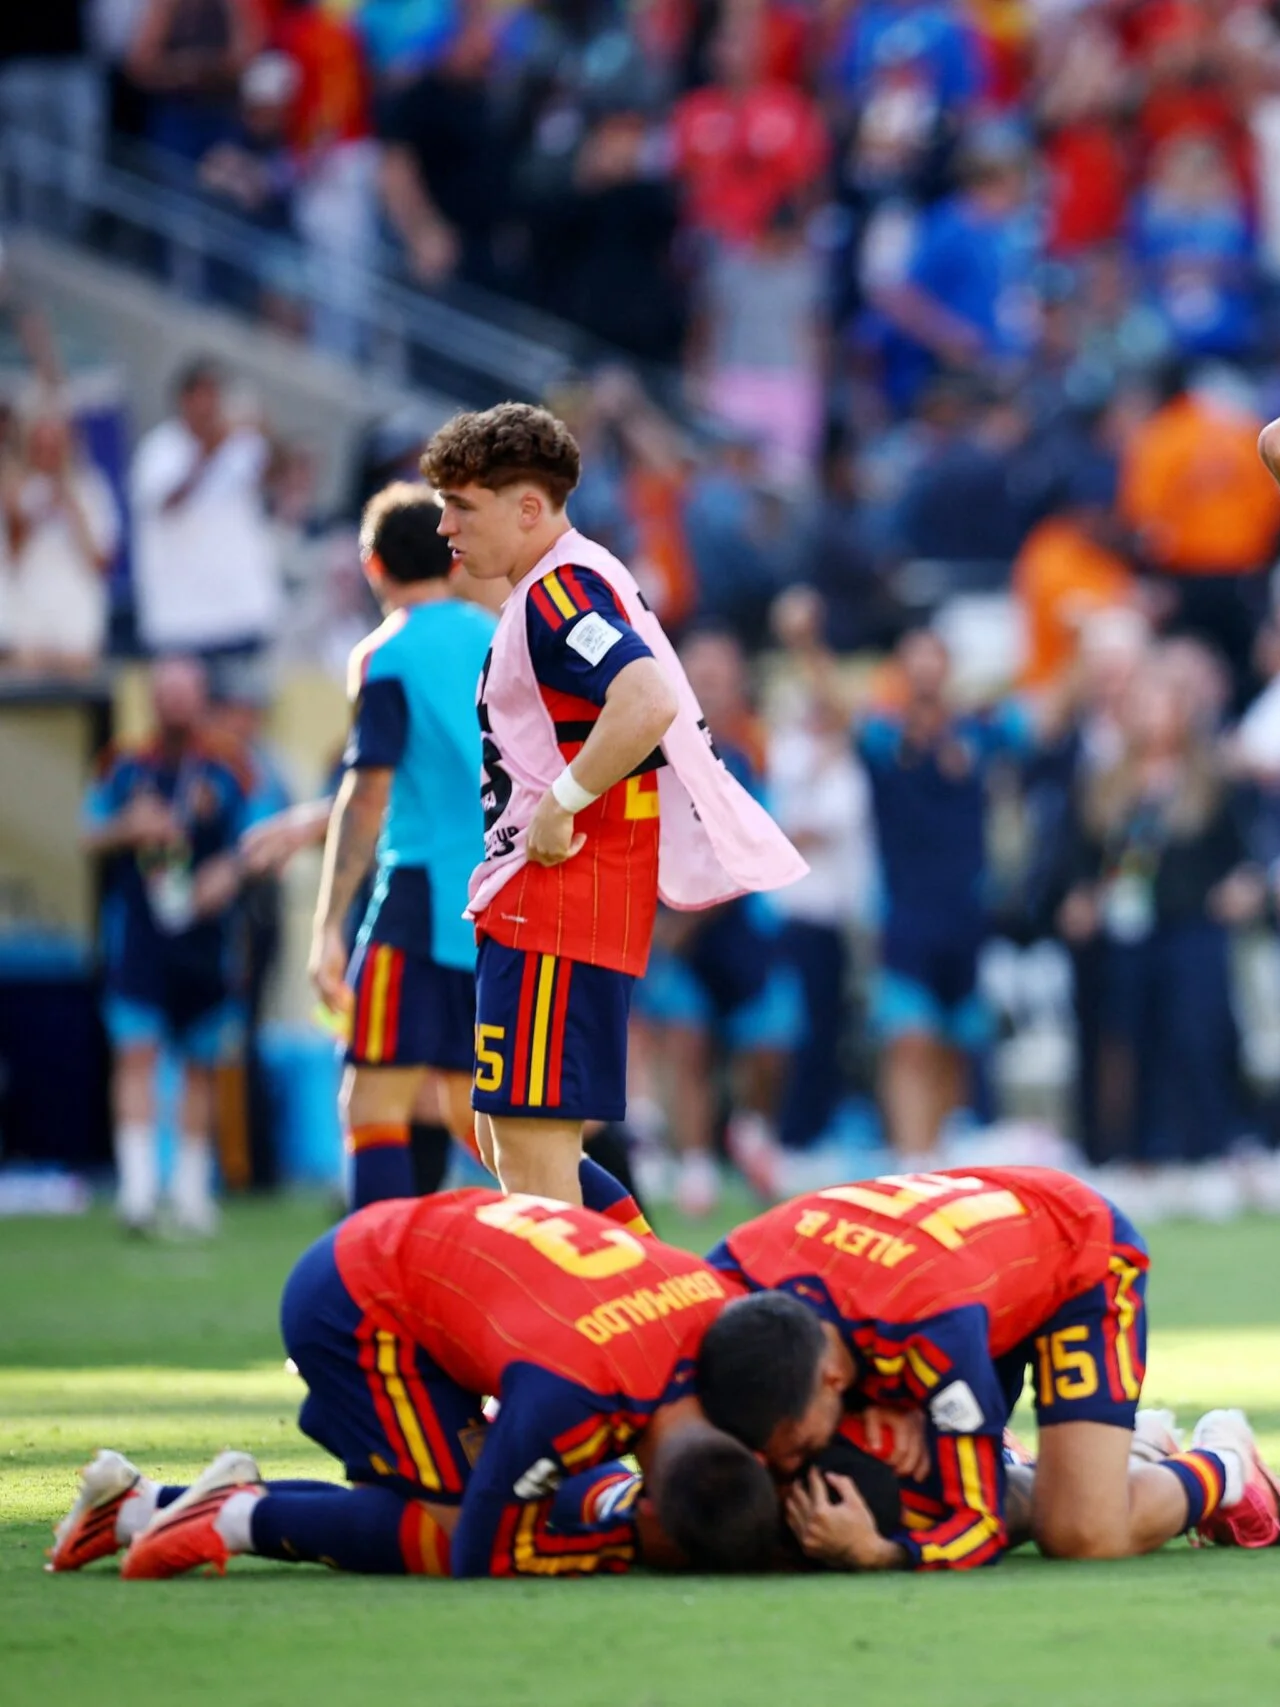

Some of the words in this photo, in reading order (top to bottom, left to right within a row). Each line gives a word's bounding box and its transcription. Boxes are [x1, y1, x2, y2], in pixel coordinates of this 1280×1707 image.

[475, 1023, 505, 1092] 5
[475, 1193, 646, 1279] 3
[822, 1219, 917, 1268] ALEX
[575, 1270, 725, 1344] GRIMALDO
[1036, 1325, 1098, 1405] 15
